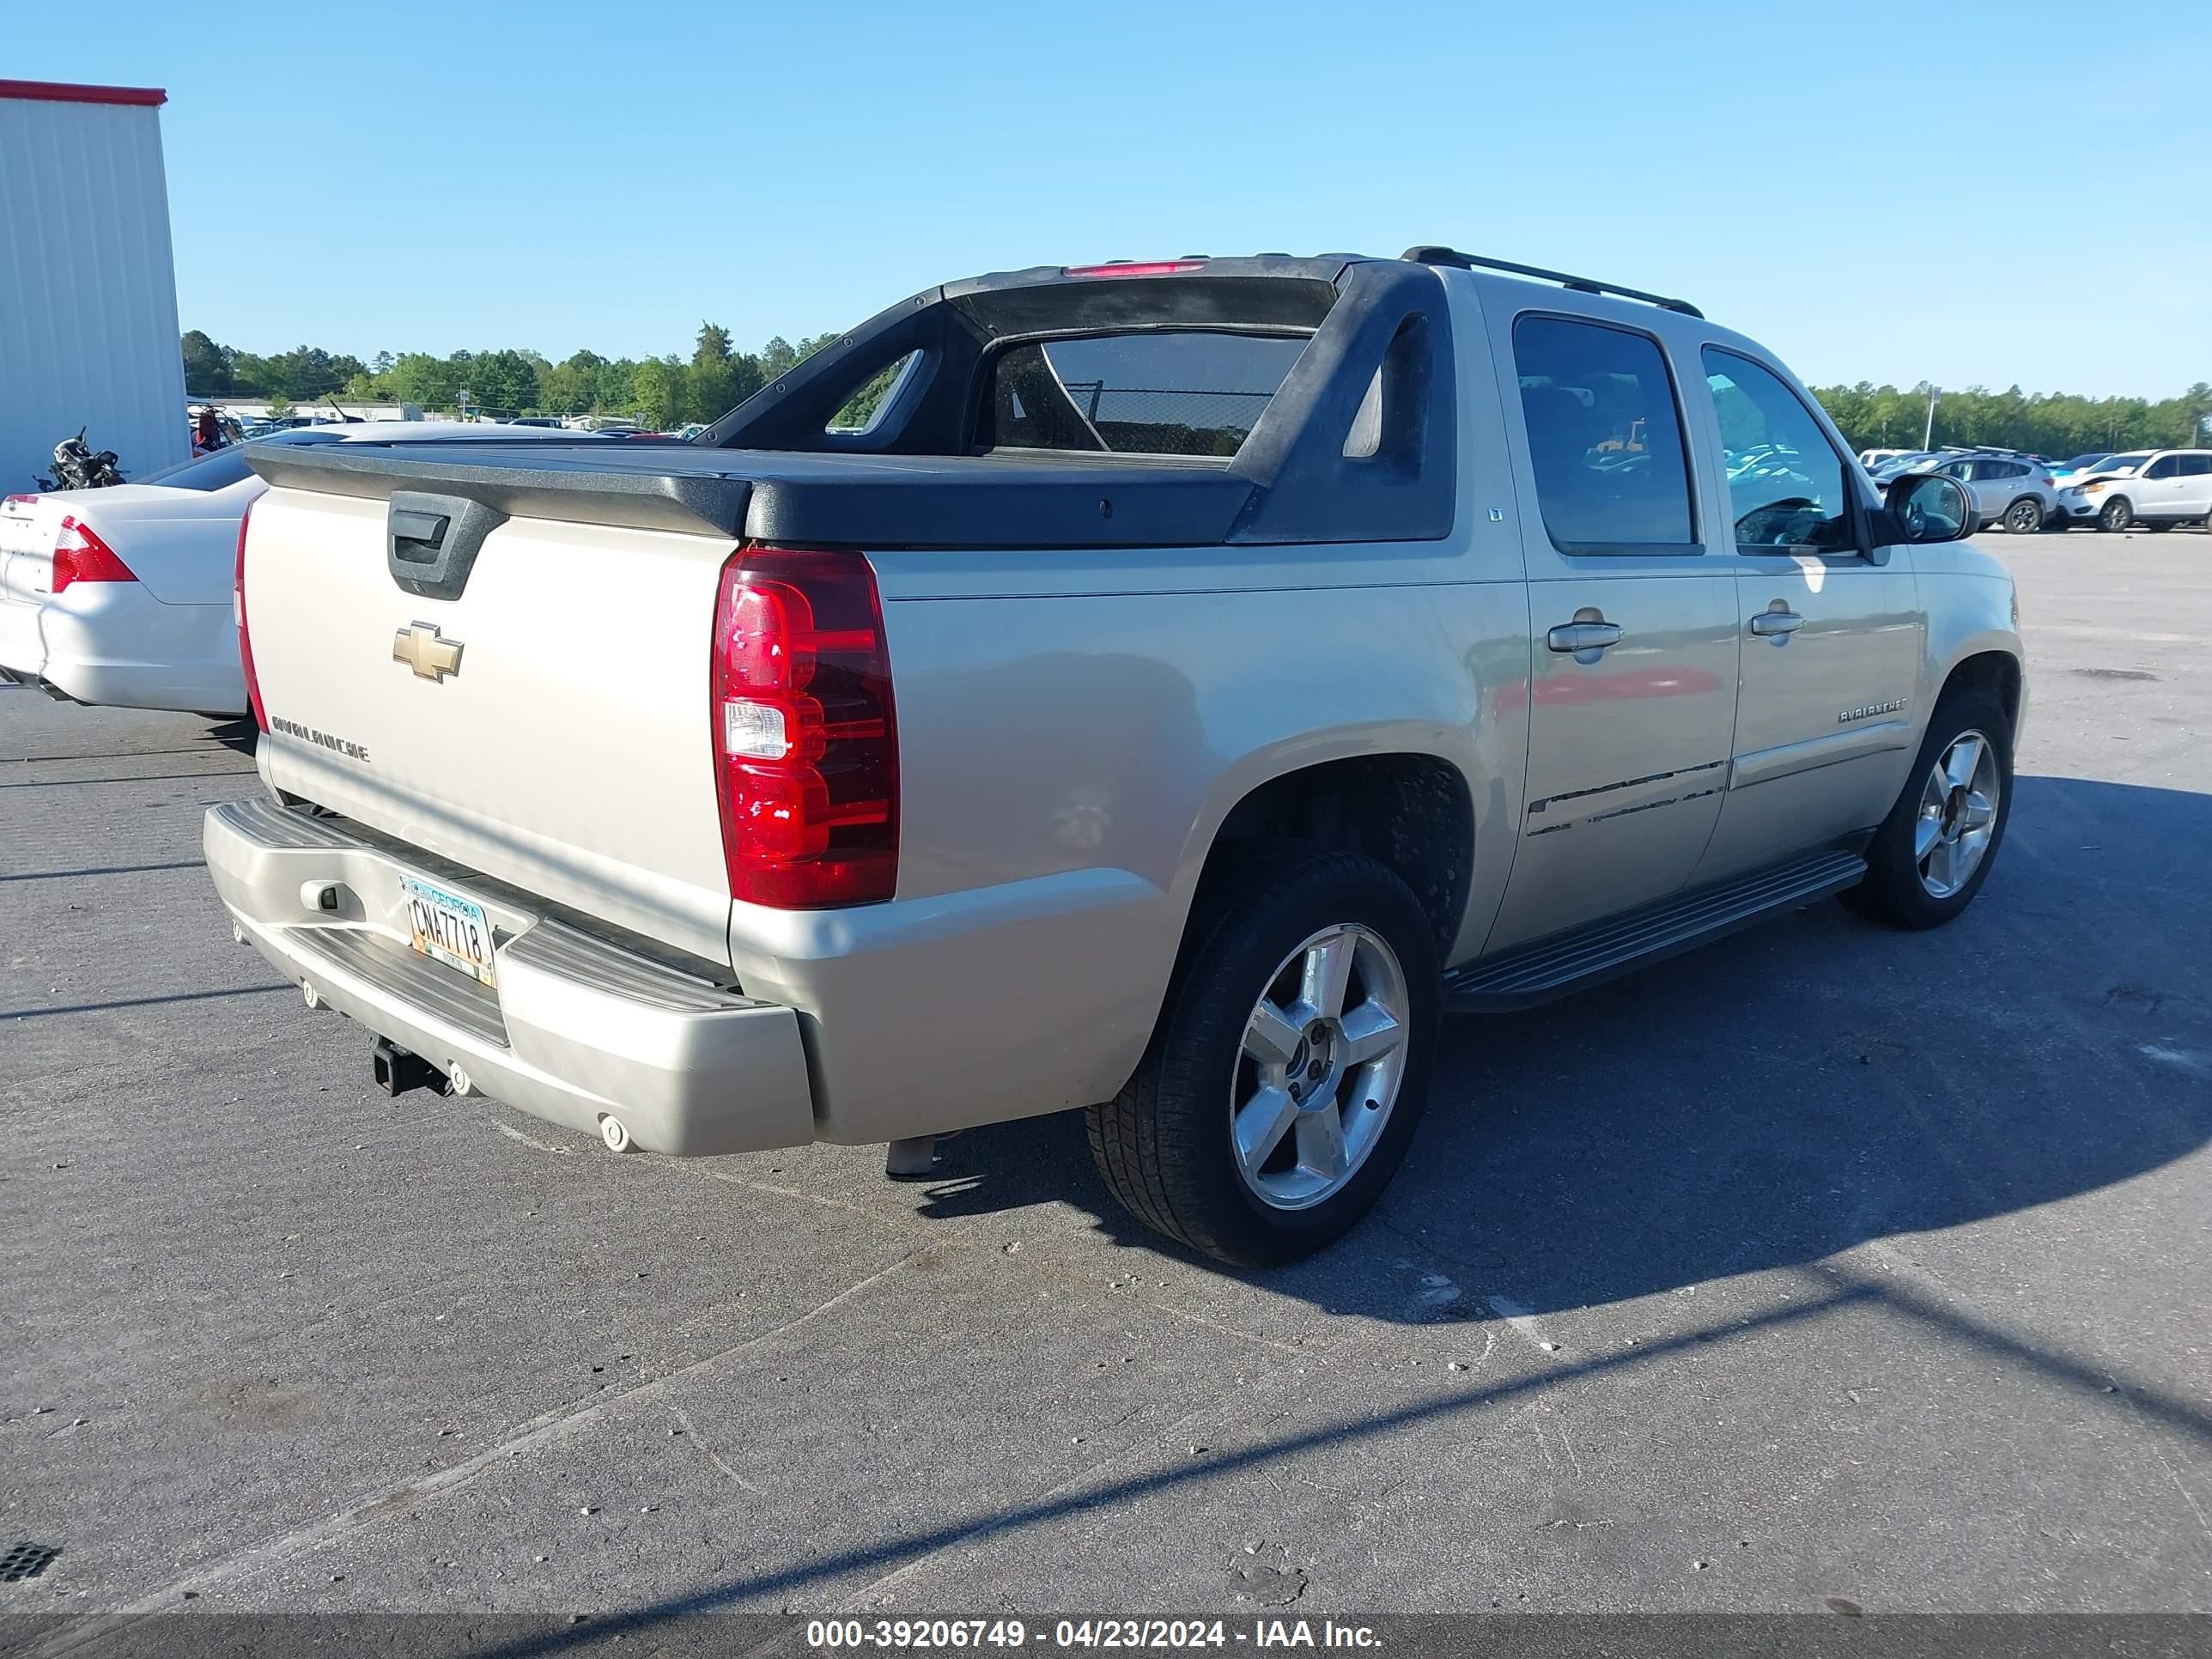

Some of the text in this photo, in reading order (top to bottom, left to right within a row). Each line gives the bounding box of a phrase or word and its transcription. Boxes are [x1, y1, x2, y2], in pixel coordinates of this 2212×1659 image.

[1838, 697, 1907, 724] AVALANCHE
[271, 715, 371, 763] AVALANCHE
[431, 890, 480, 922] GEORGIA
[412, 899, 483, 963] CNA7718
